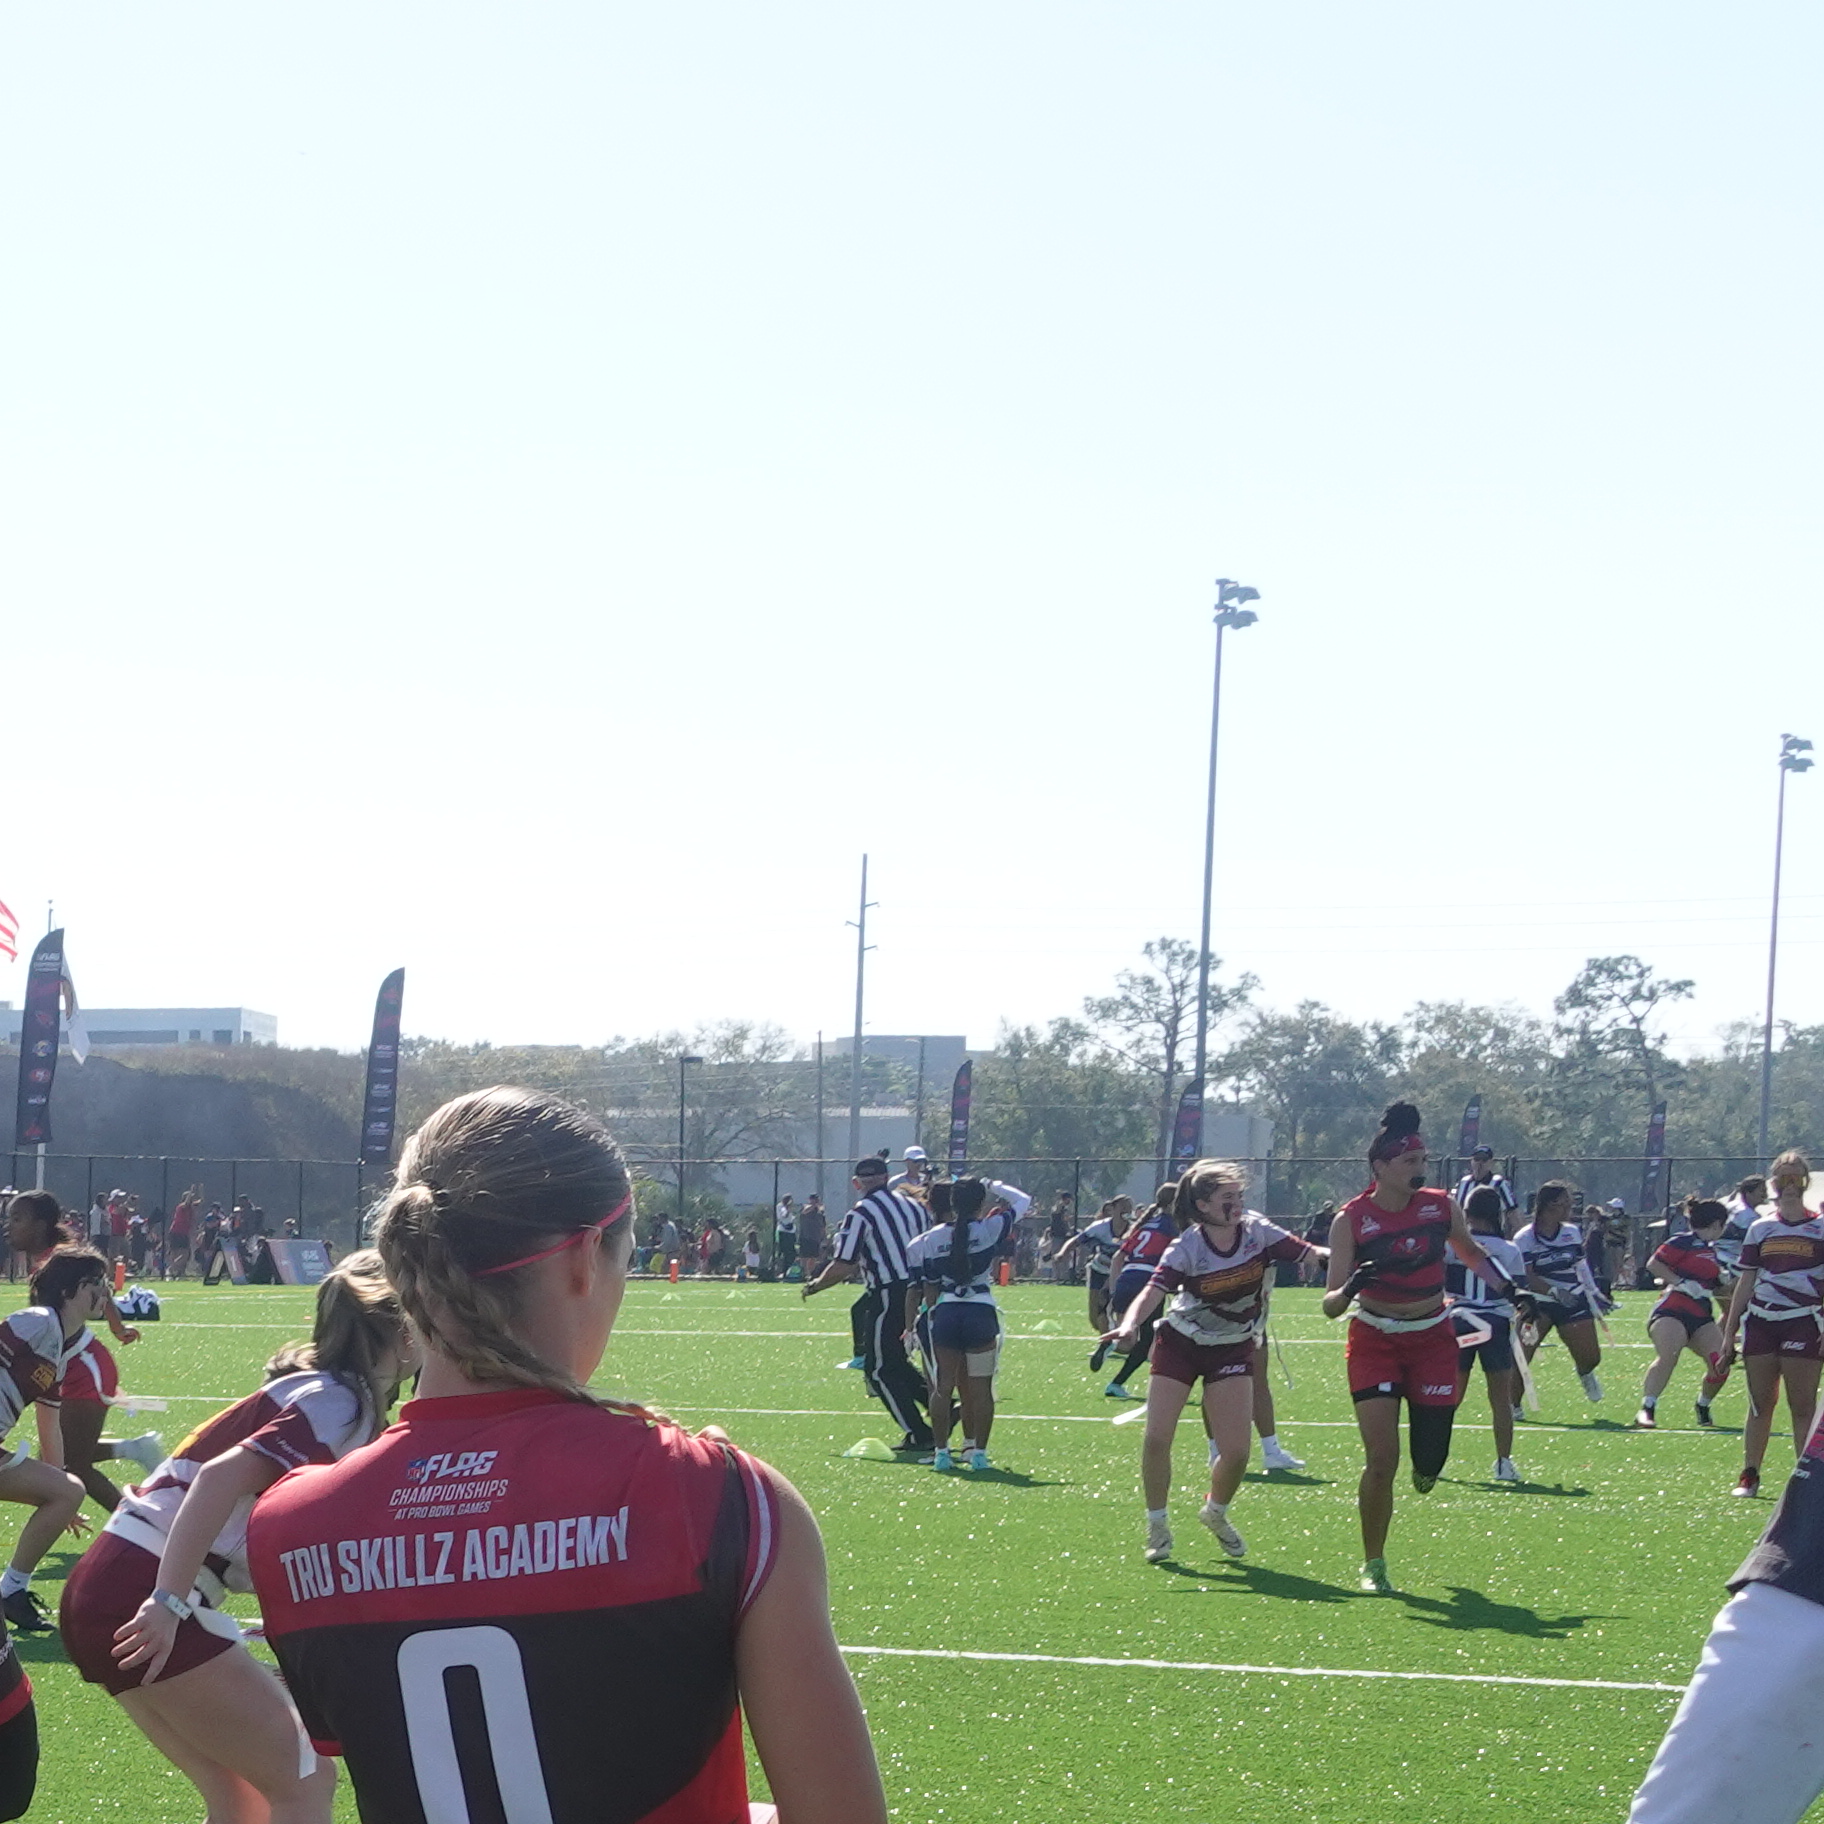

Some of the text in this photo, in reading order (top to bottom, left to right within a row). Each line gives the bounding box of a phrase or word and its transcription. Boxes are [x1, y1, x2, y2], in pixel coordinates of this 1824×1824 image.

[1132, 1230, 1152, 1259] 2
[419, 1450, 499, 1485] FLAG
[389, 1479, 509, 1506] CHAMPIONSHIPS
[395, 1500, 492, 1520] AT PRO BOWL GAMES
[279, 1505, 630, 1604] TRU SKILLZ ACADEMY
